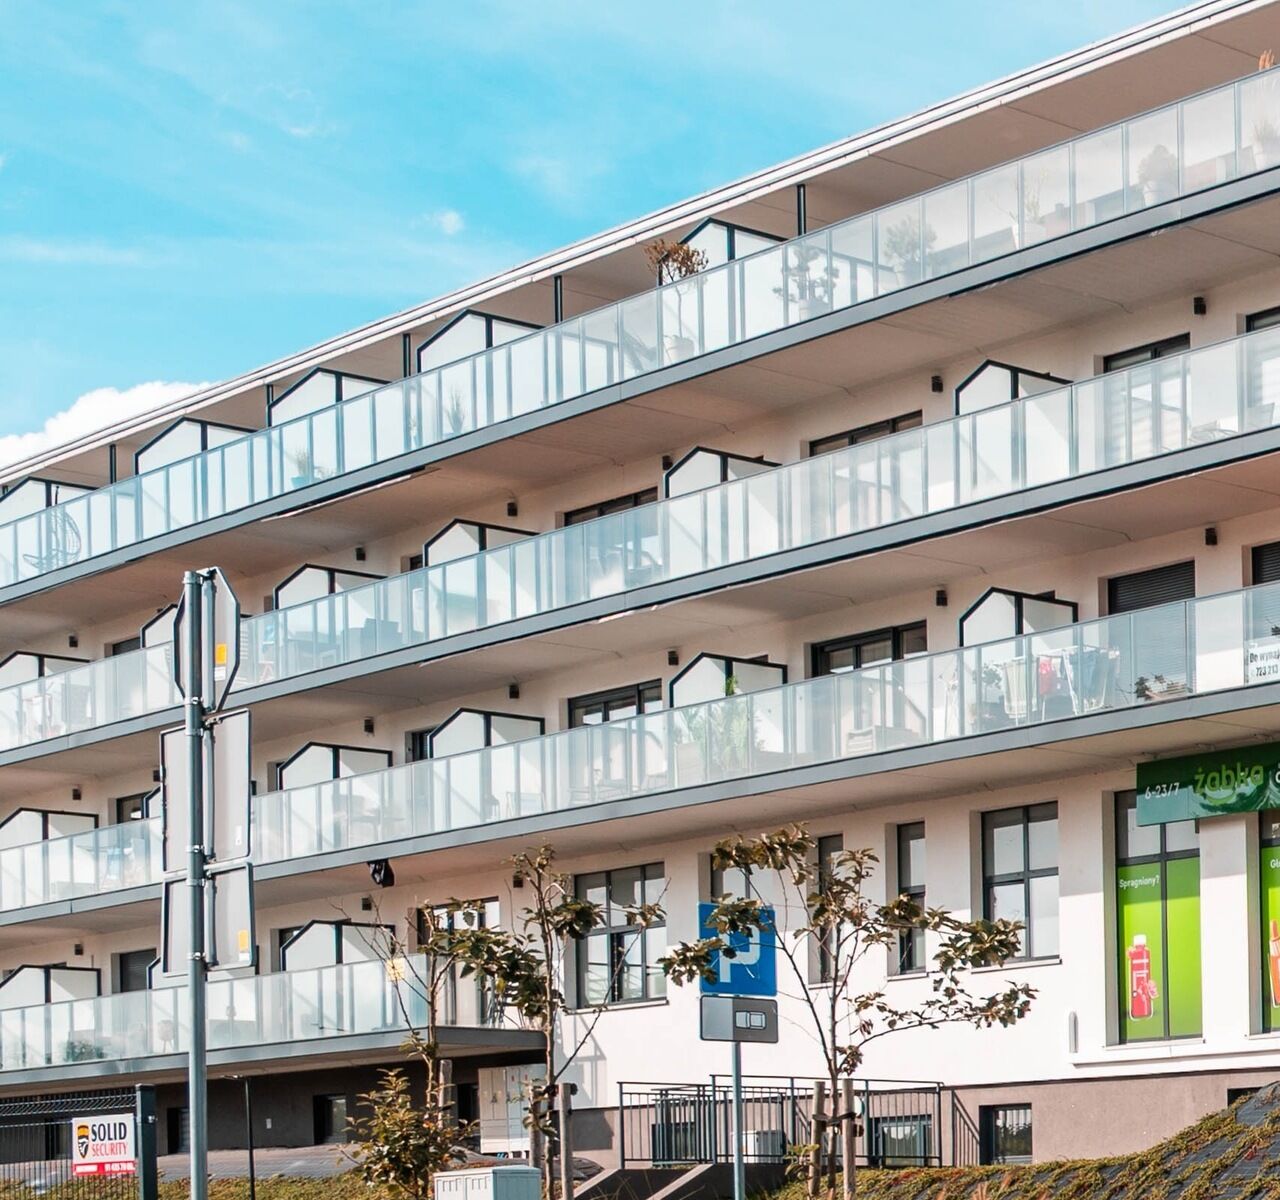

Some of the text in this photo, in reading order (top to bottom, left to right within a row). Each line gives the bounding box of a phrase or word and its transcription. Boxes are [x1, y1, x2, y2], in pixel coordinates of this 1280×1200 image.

[1194, 762, 1265, 797] żabka
[1119, 875, 1160, 890] Spragniony?
[91, 1122, 127, 1142] SOLID
[91, 1142, 128, 1157] SECURITY
